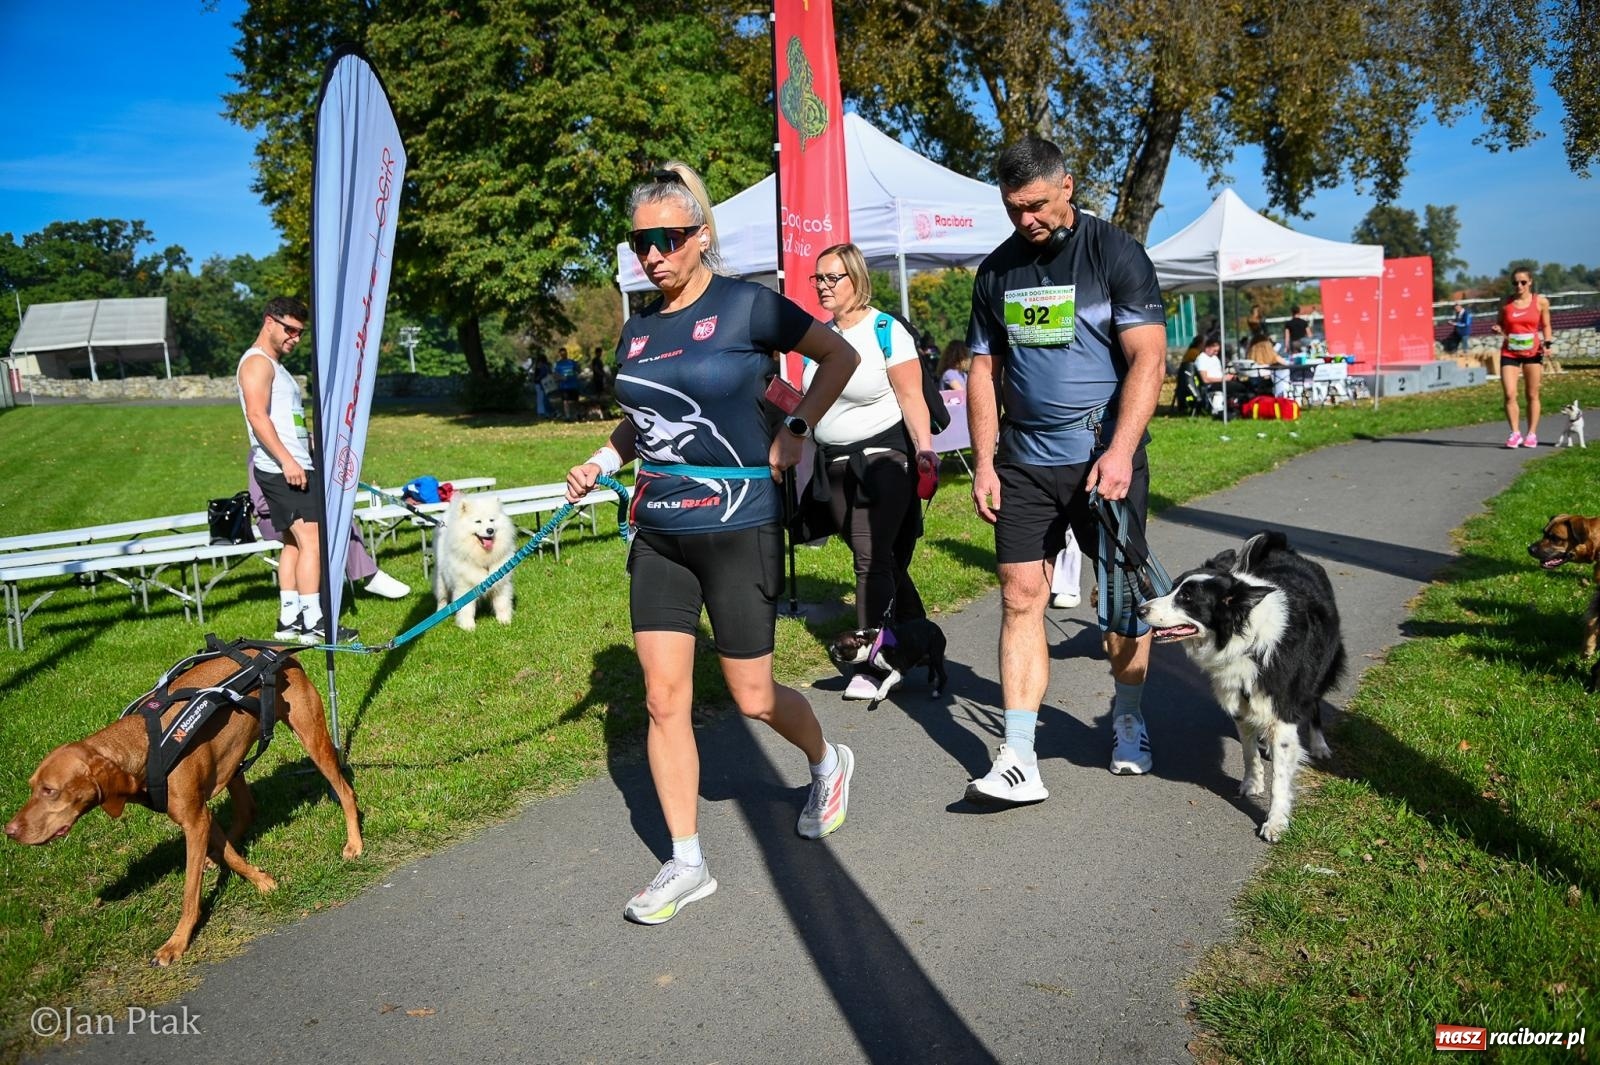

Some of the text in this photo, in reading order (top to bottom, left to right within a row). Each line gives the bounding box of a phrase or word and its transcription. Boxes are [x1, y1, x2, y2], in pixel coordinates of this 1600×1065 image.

[802, 213, 833, 233] coś
[934, 214, 974, 228] Racibórz
[1024, 306, 1050, 325] 92
[1437, 365, 1442, 380] 1
[1468, 372, 1475, 383] 3
[1398, 377, 1406, 392] 2
[181, 700, 208, 730] Non-stop
